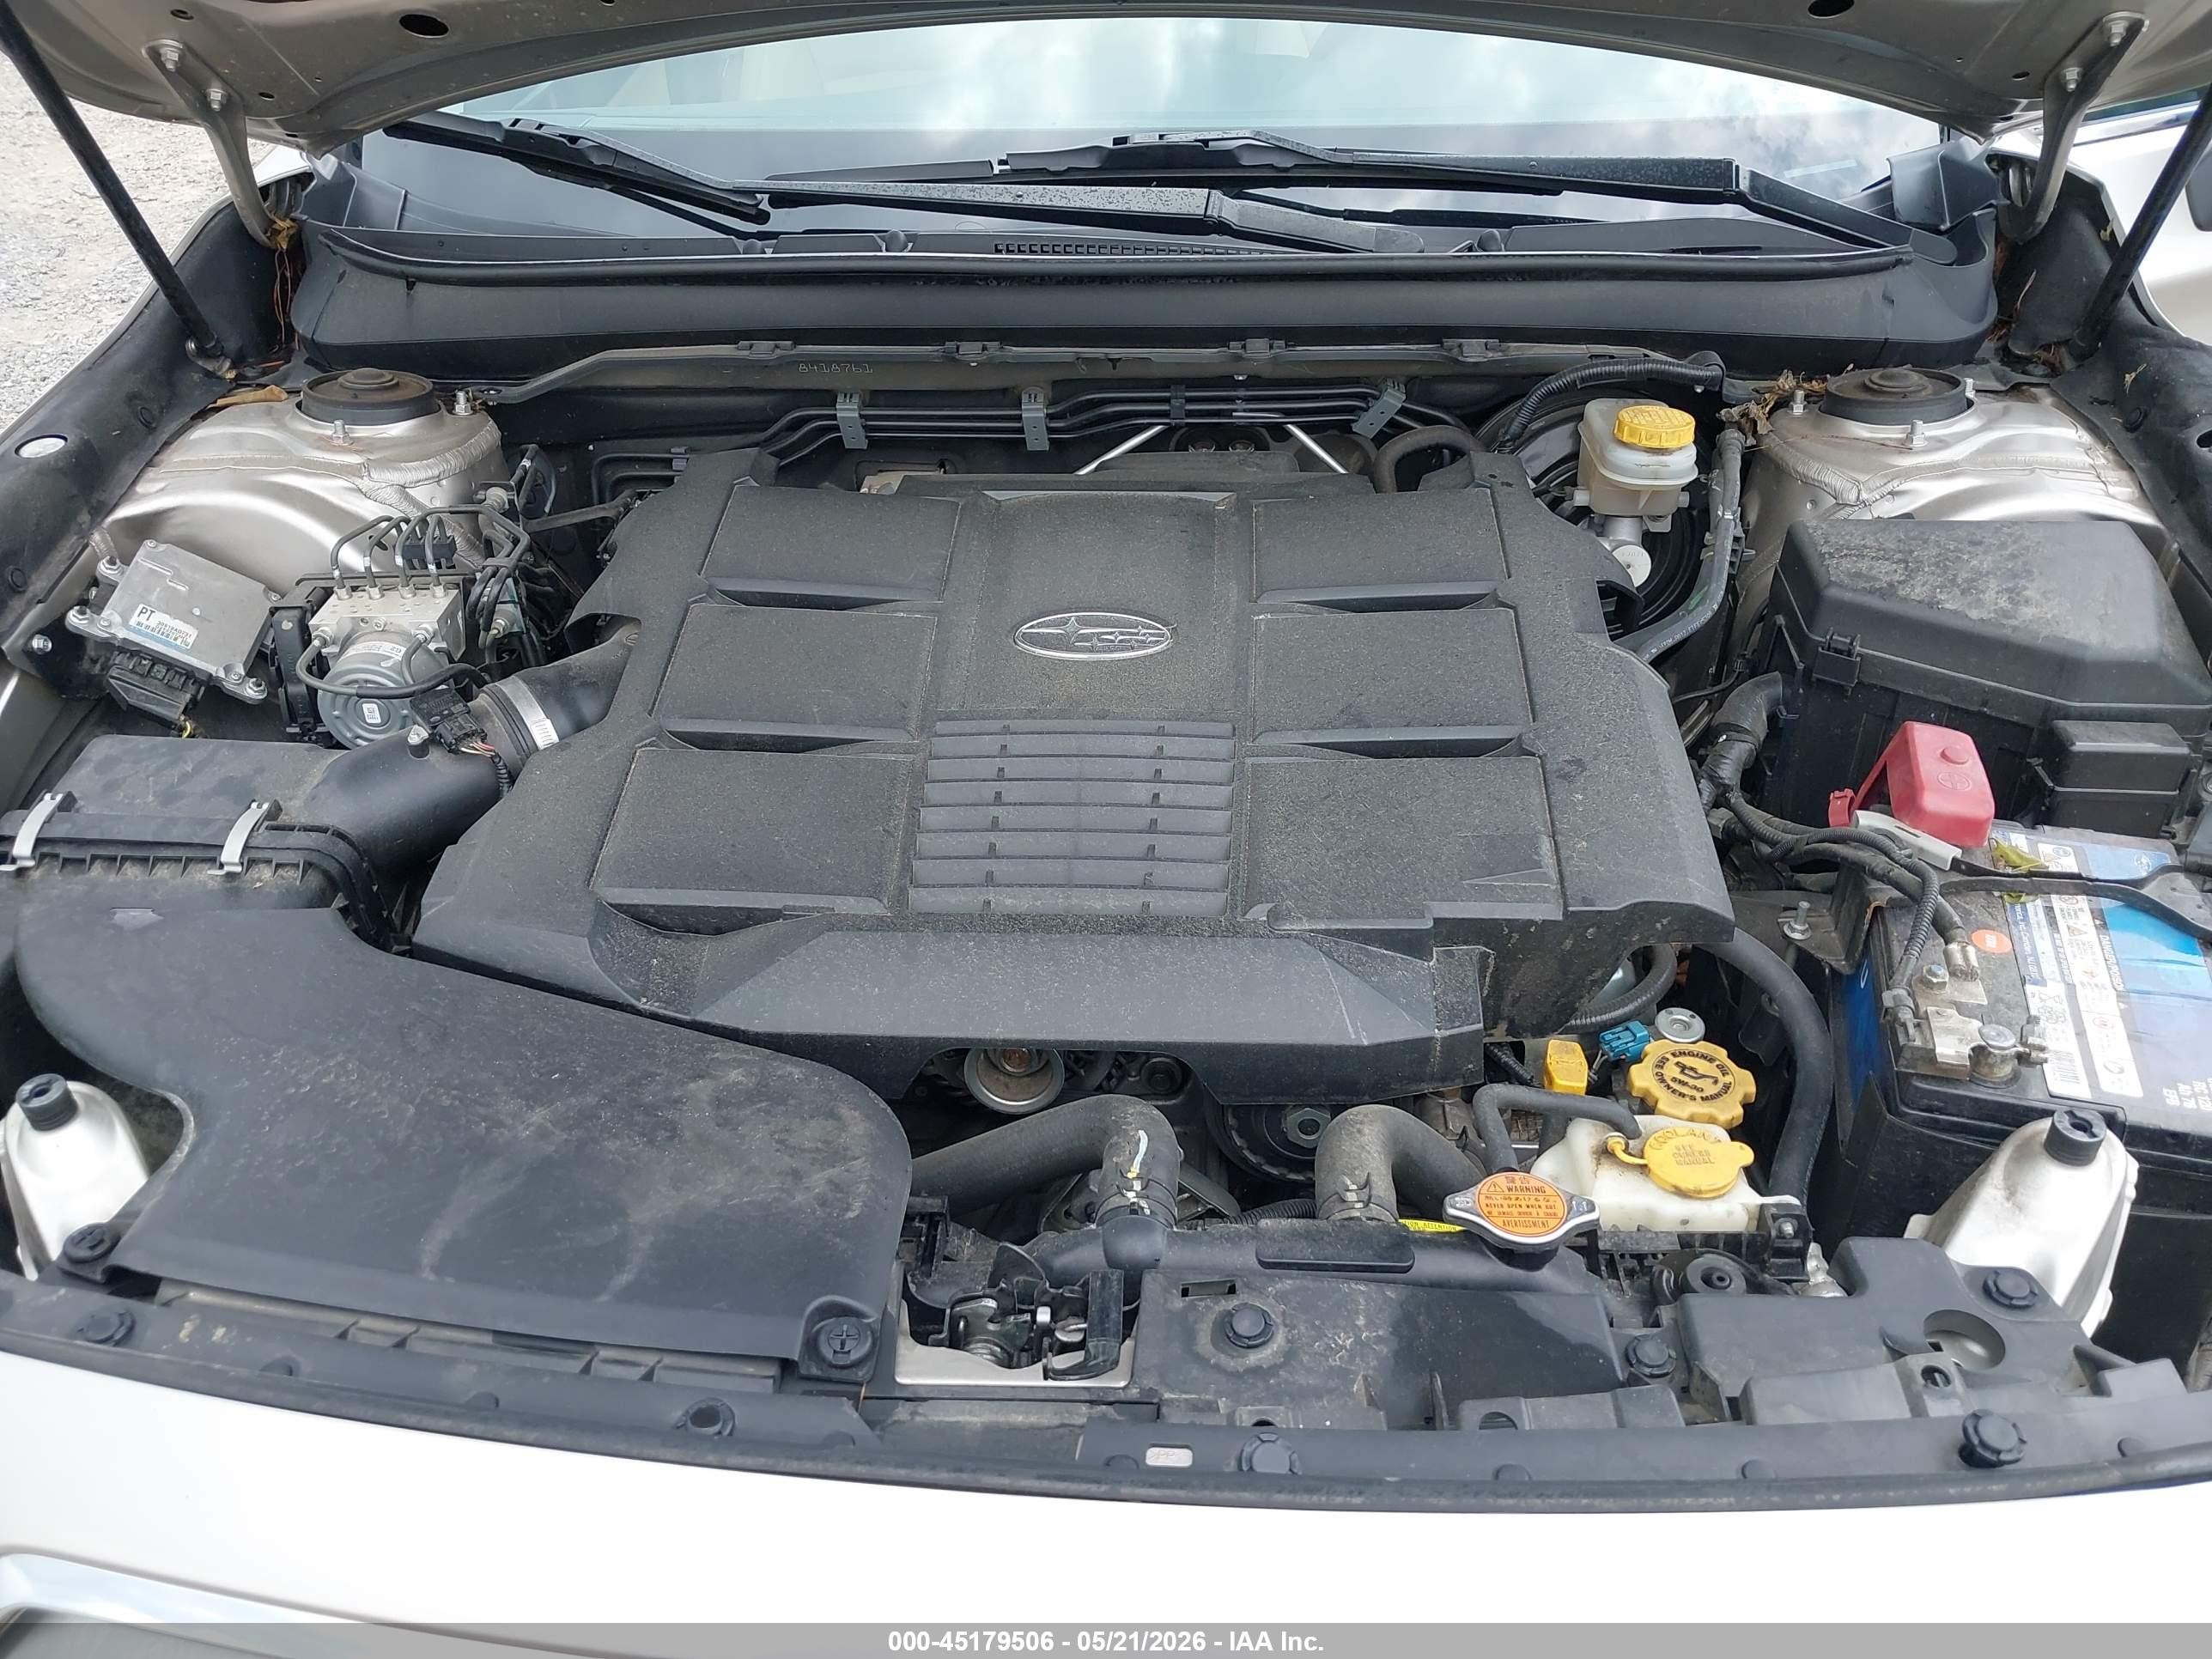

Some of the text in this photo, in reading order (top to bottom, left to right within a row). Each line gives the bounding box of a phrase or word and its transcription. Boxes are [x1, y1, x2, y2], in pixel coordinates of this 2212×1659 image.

[799, 363, 873, 374] 8418761
[137, 606, 155, 621] PT
[1670, 1050, 1730, 1077] ENGINE OIL
[1655, 1055, 1732, 1102] SEE OWNER'S MANUAL
[1670, 1077, 1705, 1092] 5W-30
[1649, 1127, 1722, 1150] COOLANT
[1506, 1185, 1547, 1194] WARNING
[1503, 1219, 1550, 1229] AVERTISSMENT
